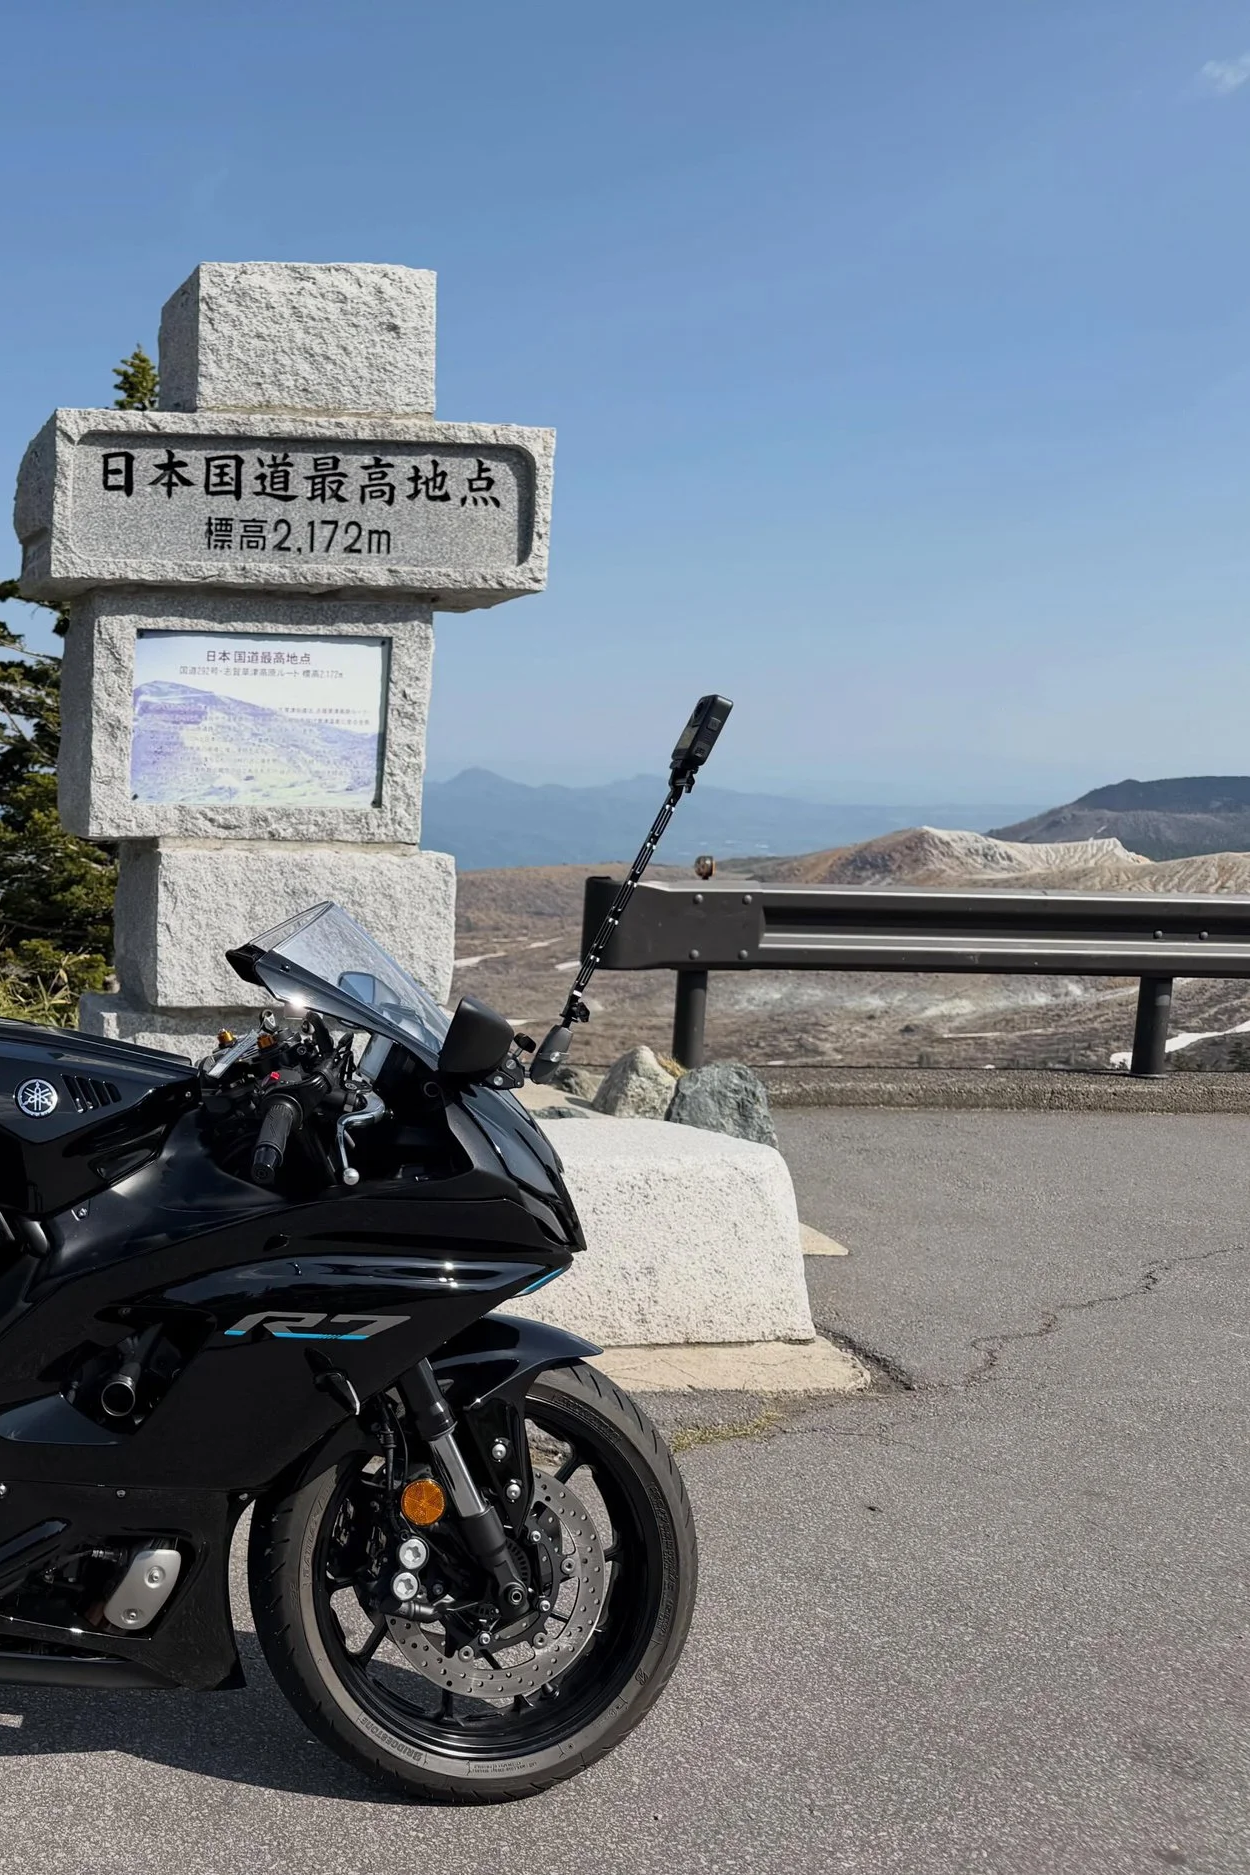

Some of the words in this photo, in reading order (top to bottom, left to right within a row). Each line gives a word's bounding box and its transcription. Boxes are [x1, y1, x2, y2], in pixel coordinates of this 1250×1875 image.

[100, 449, 502, 509] 日本国道最高地点
[204, 516, 392, 556] 標高2,172m
[206, 650, 312, 665] 日本国道最高地点
[224, 1310, 411, 1341] R7
[359, 1716, 424, 1762] BRIDGESTONE
